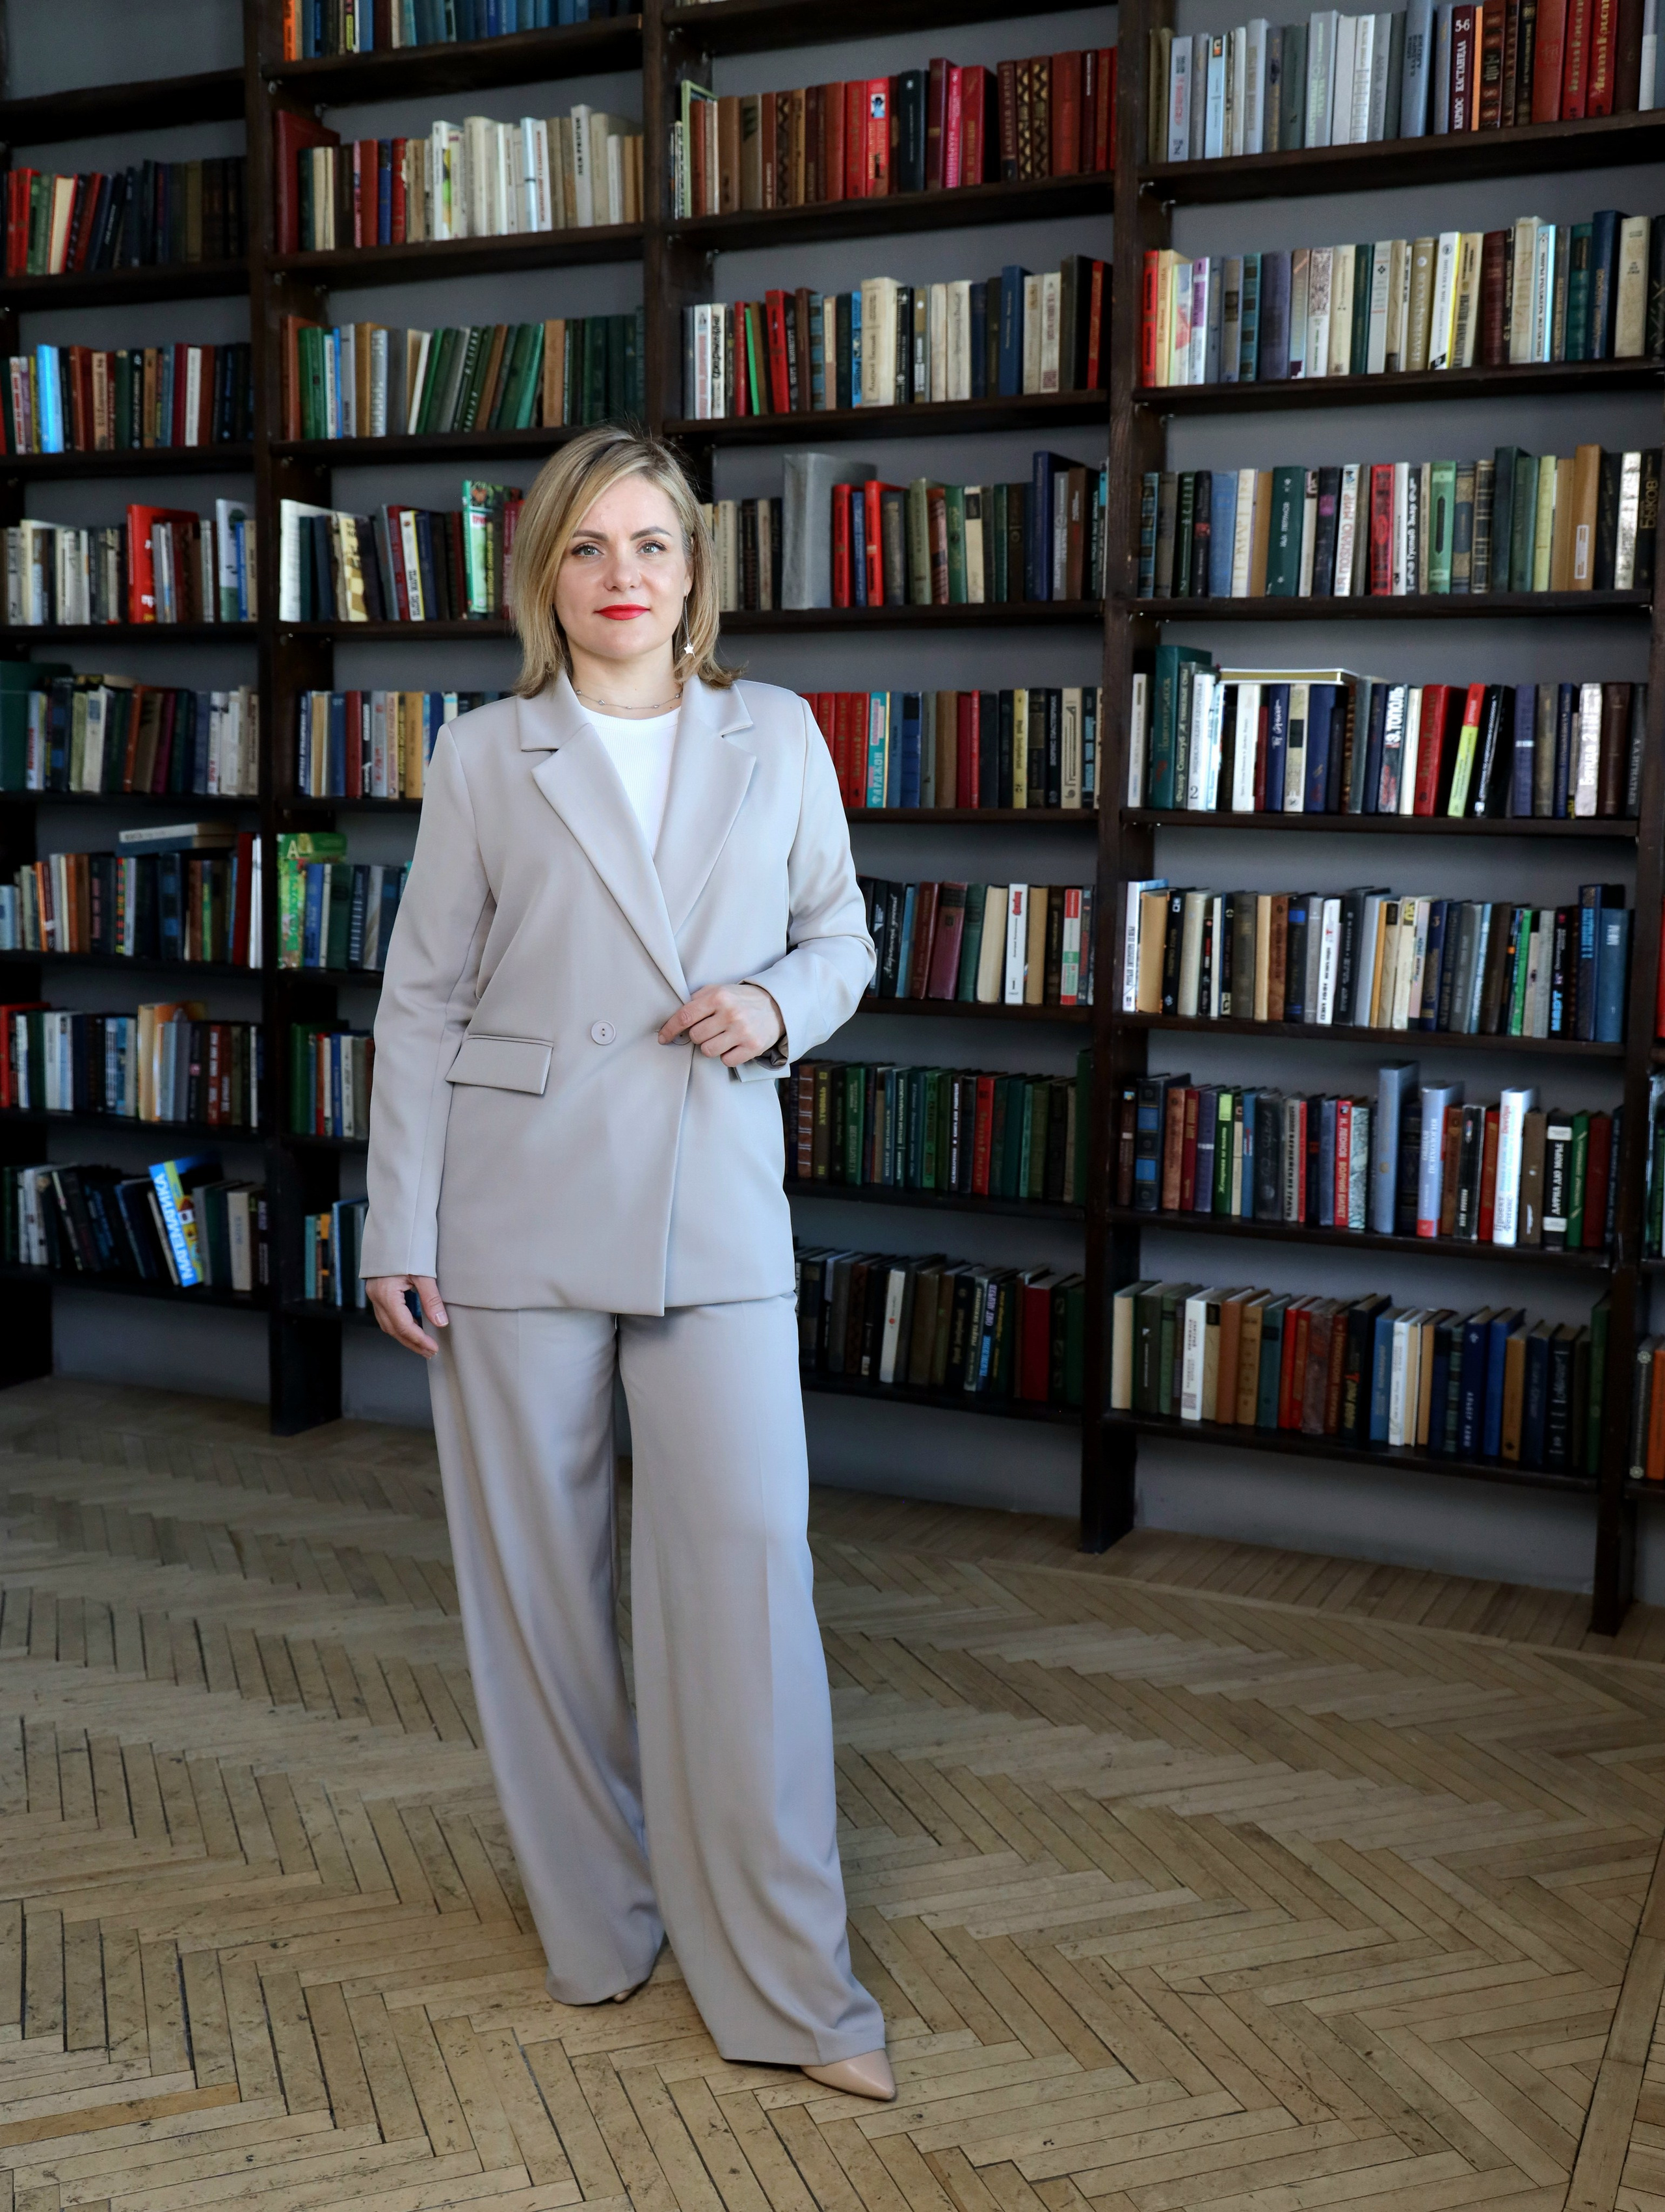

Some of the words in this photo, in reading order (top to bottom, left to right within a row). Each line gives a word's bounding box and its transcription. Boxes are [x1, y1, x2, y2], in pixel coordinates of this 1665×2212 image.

[1455, 18, 1471, 31] 5-6
[1455, 40, 1467, 92] КАСТАНЕДА
[1454, 96, 1464, 129] КАРЛОС
[1342, 494, 1353, 519] МИР
[1409, 504, 1418, 527] Эмар
[1640, 479, 1658, 528] БЫКОВ
[1339, 524, 1352, 574] ПОЗНАЮ
[1408, 529, 1417, 561] Густав
[1386, 687, 1404, 742] Э.ТОПОЛЬ
[1582, 733, 1596, 741] 2
[873, 753, 883, 804] ФАРДЖОН
[1580, 743, 1595, 786] Банда
[1191, 786, 1199, 799] 2
[1339, 1126, 1348, 1158] ЛЕОНОВ
[1421, 1130, 1430, 1161] ОБЩАЯ
[1428, 1118, 1437, 1174] ПСИХОЛОГИЯ
[1554, 1143, 1564, 1169] МОРЬЕ
[1337, 1195, 1346, 1218] БИЛЕТ
[1495, 1197, 1504, 1231] Проект
[1551, 1186, 1561, 1215] ДАФНА
[156, 1173, 194, 1279] МАТЕМАТИКА
